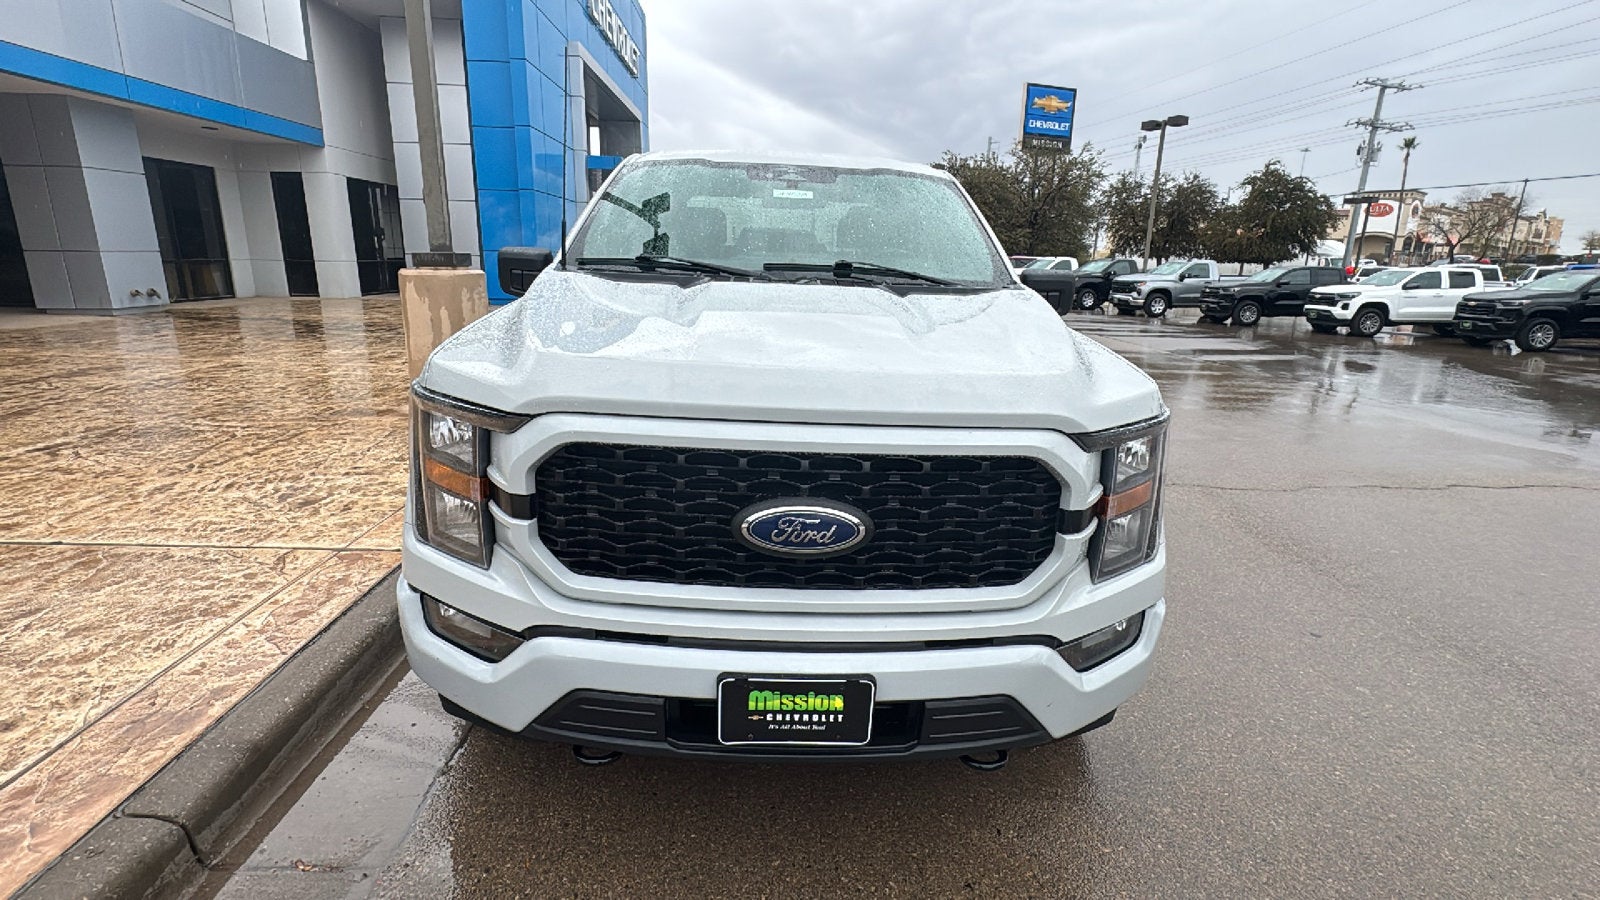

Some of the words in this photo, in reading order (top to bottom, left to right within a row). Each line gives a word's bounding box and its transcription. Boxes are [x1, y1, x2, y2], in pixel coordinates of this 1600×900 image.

[1028, 119, 1070, 131] CHEVROLET
[771, 516, 837, 543] Ford
[748, 690, 844, 711] Mission
[766, 713, 844, 722] CHEVROLET
